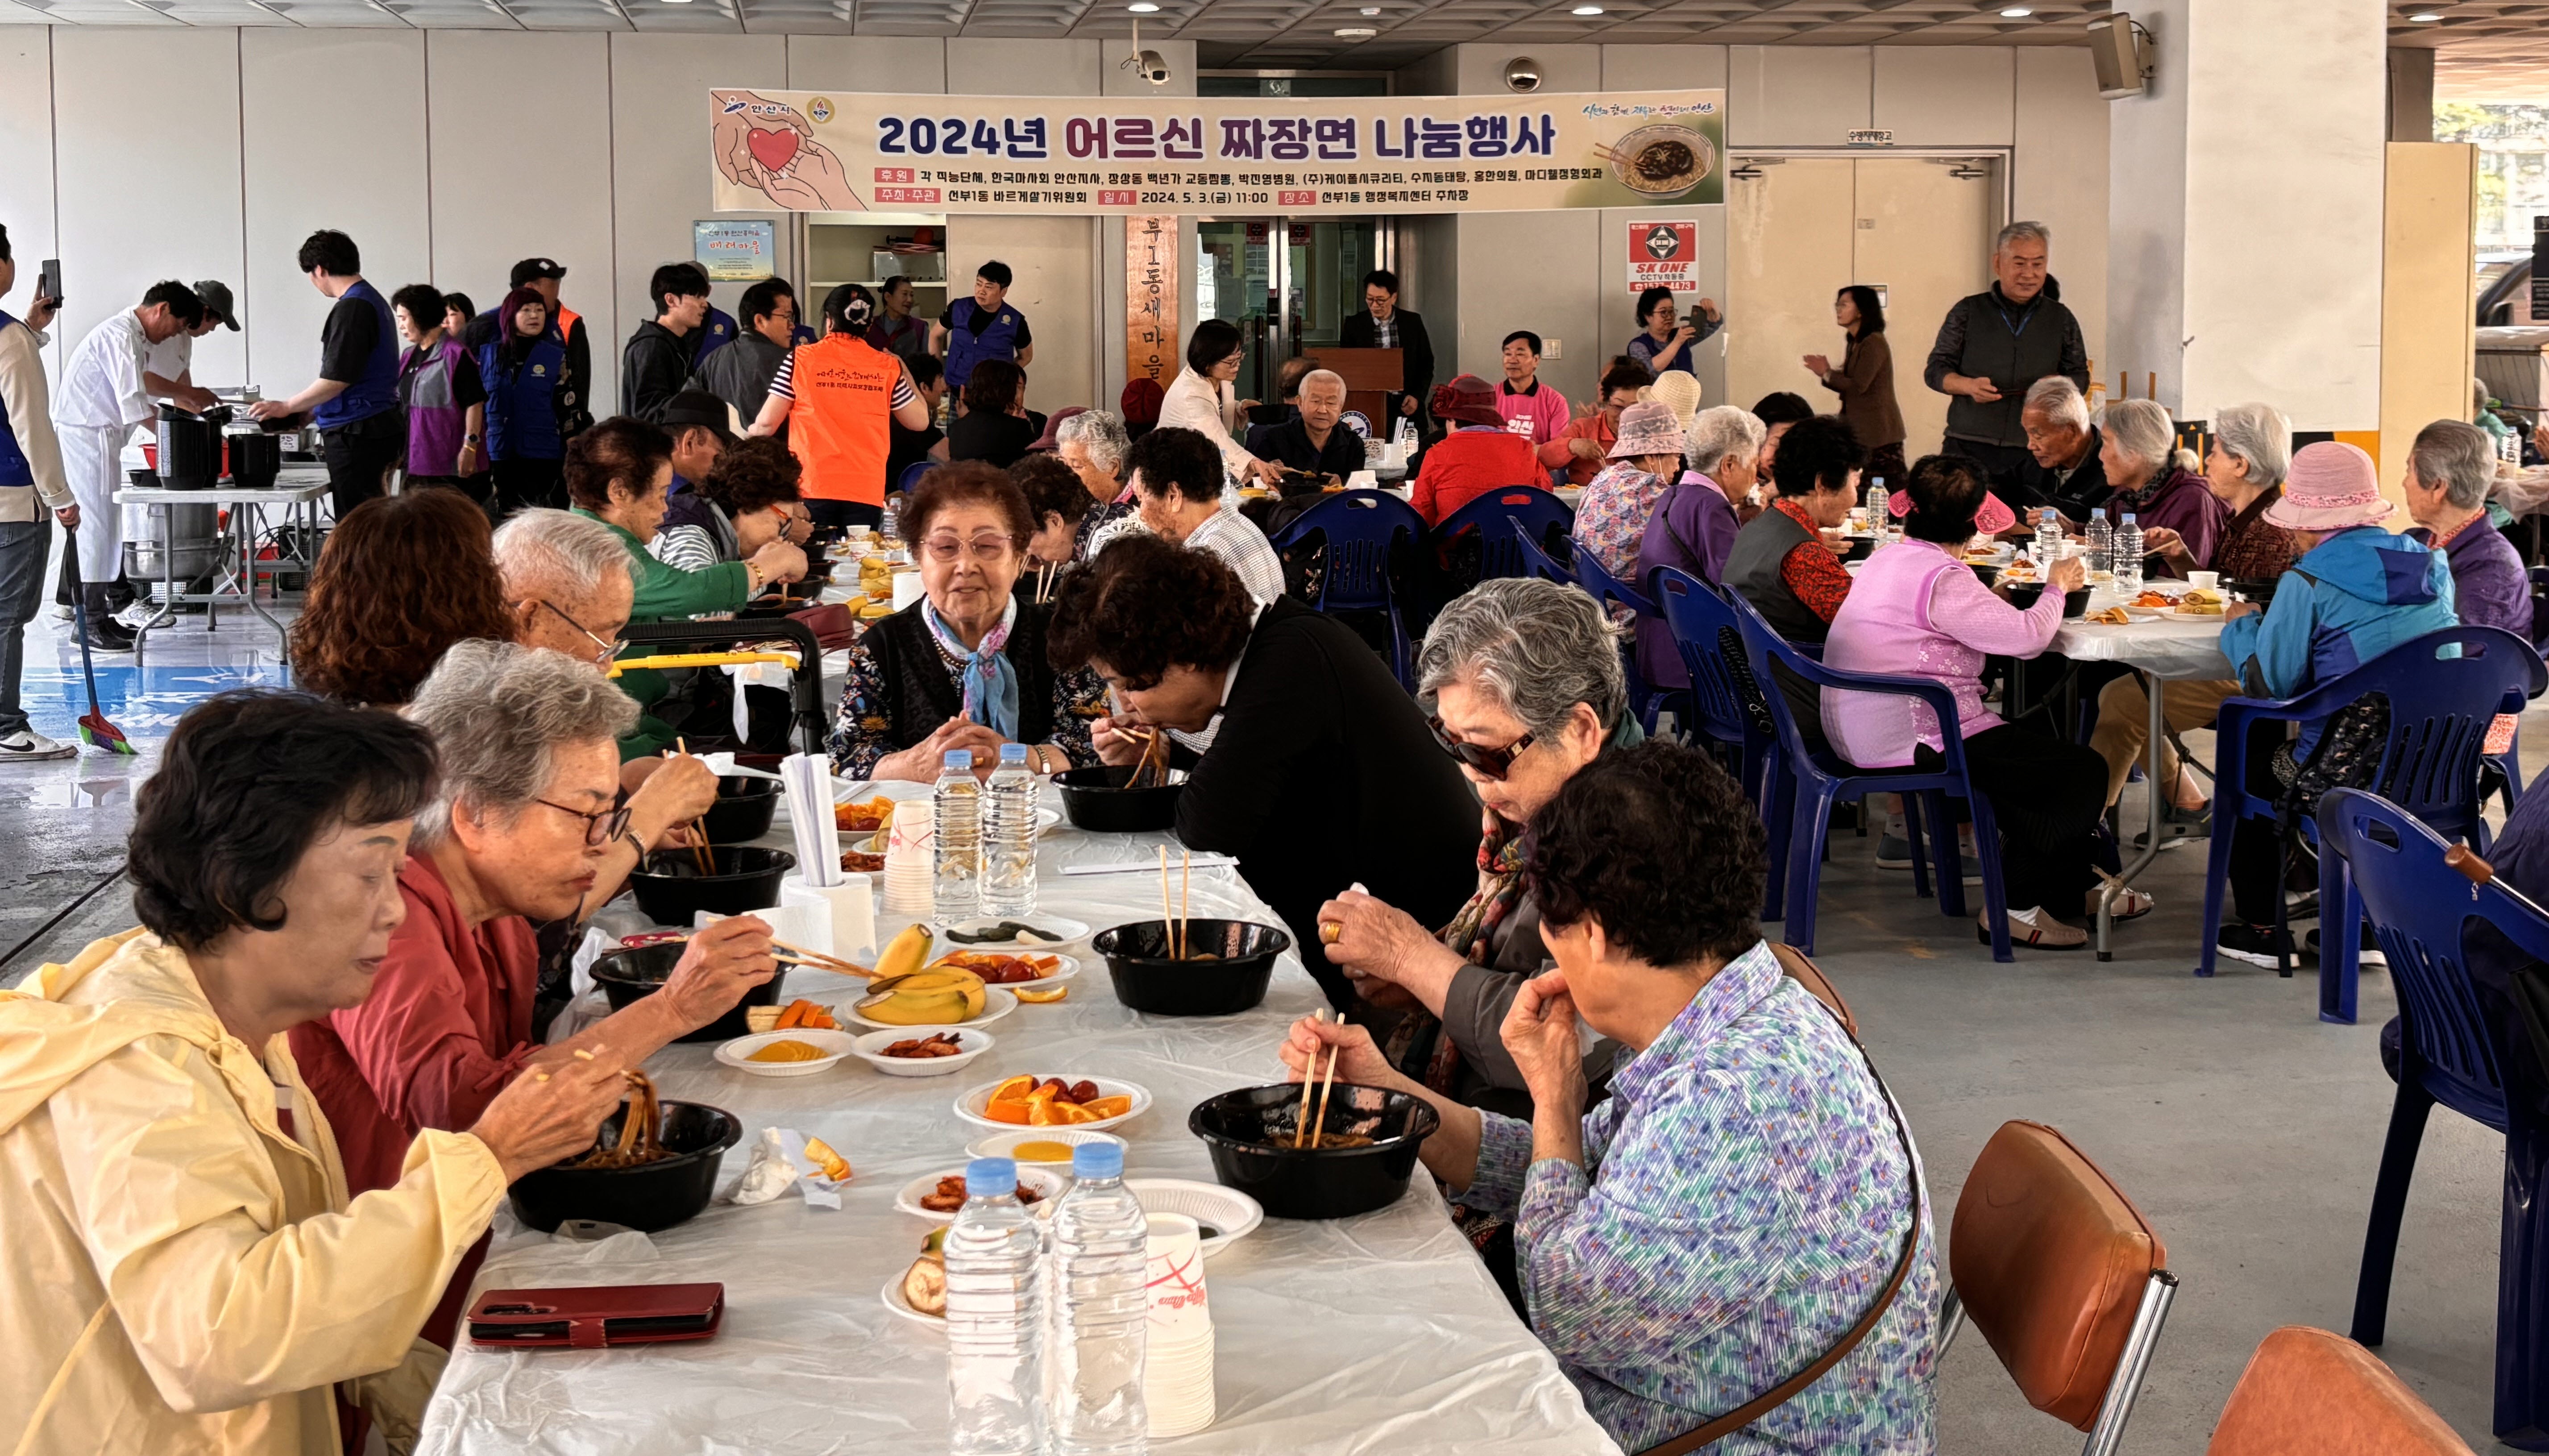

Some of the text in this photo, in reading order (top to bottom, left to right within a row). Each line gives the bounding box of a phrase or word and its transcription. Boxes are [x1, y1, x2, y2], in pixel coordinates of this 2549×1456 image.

[751, 105, 790, 115] 안산시
[1691, 103, 1714, 113] 안산
[879, 114, 1556, 160] 2024년 어르신 짜장면 나눔행사
[920, 170, 931, 182] 각
[936, 171, 987, 184] 직능단체,
[992, 172, 1050, 184] 한국마사회
[1054, 173, 1104, 185] 안산지사,
[1108, 173, 1142, 185] 장상동
[1147, 173, 1181, 185] 백년가
[1185, 173, 1235, 186] 교동짬뽕,
[1239, 173, 1299, 186] 박진영병원,
[1411, 172, 1470, 184] 수지동태탕,
[1474, 170, 1521, 182] 홍한의원,
[948, 190, 1087, 203] 선부1동 바르게살기위원회
[1142, 192, 1179, 203] 2024.
[1183, 192, 1195, 203] 5.
[1236, 192, 1269, 203] 11:00
[1322, 190, 1469, 203] 선부1동 행정복지센터 주차장
[1636, 263, 1689, 273] SK ONE
[1506, 419, 1535, 435] 안산
